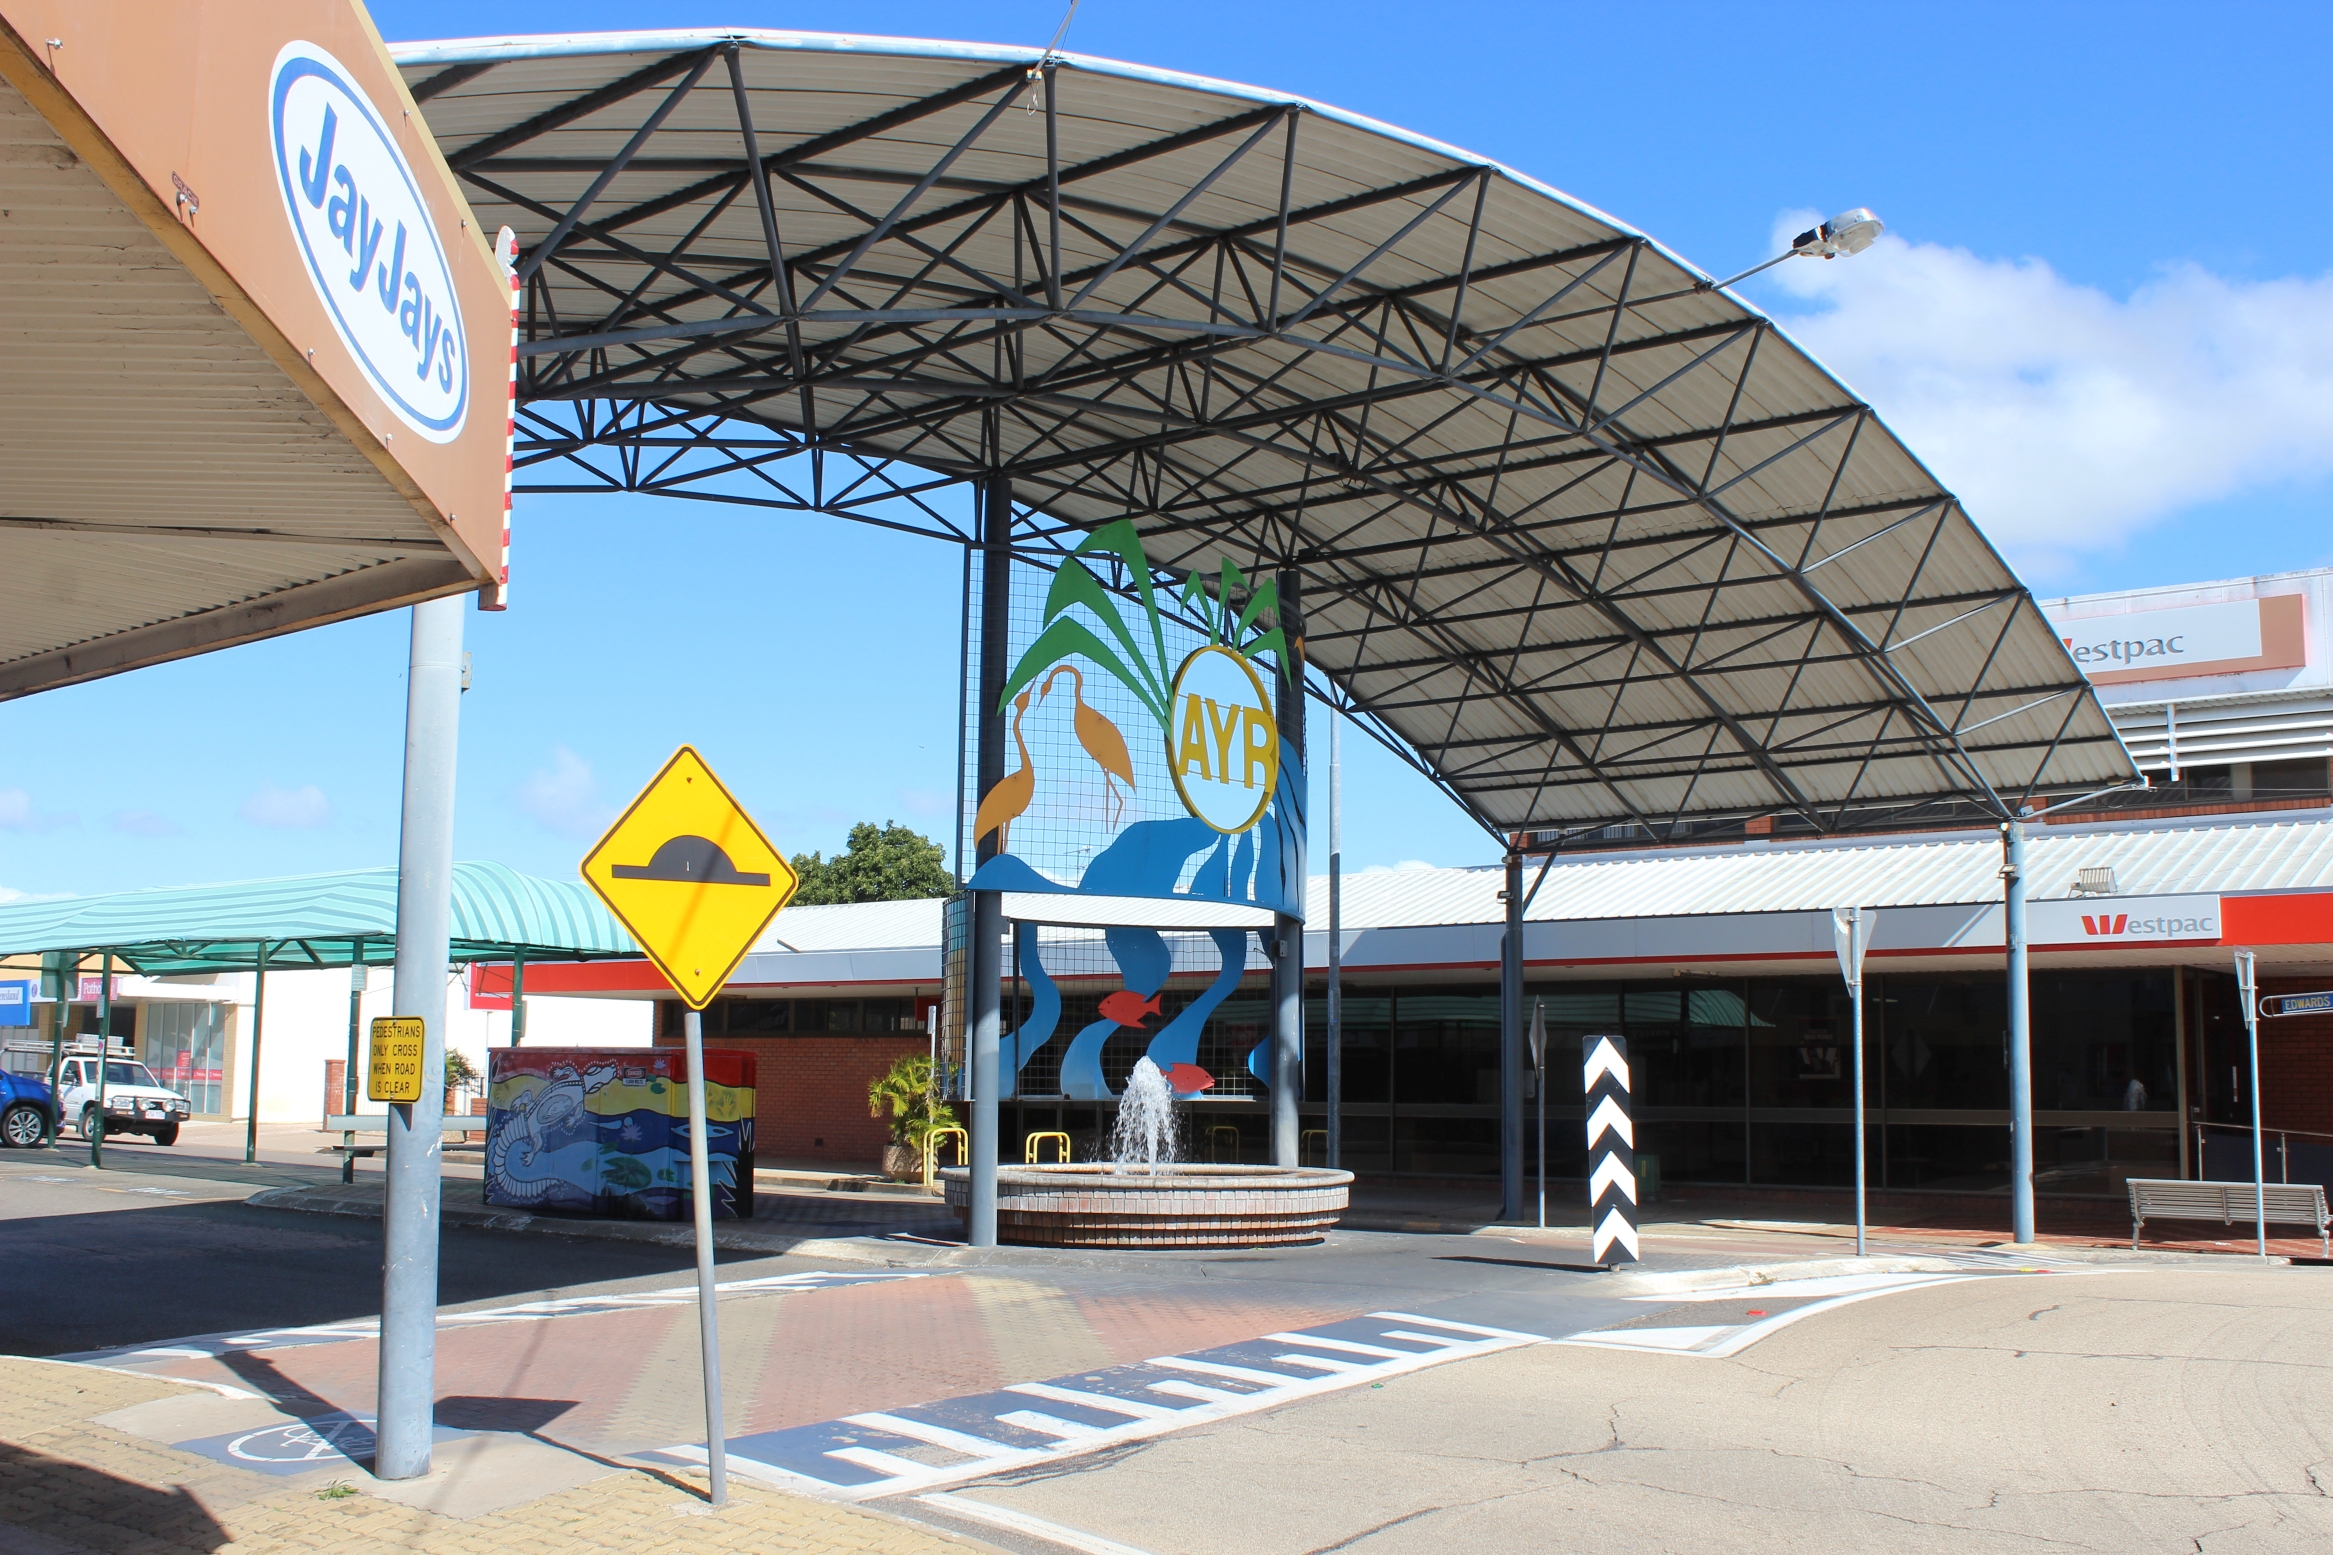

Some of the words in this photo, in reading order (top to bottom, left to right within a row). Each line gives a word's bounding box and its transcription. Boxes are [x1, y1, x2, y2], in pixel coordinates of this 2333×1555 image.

[2062, 635, 2184, 666] estpac
[1177, 692, 1276, 794] AYR
[2080, 913, 2213, 938] Westpac
[2284, 996, 2331, 1011] EDWARDS
[372, 1025, 421, 1038] PEDESTRIANS
[373, 1044, 389, 1056] ONLY
[392, 1044, 418, 1056] CROSS
[373, 1063, 391, 1075] WHEN
[394, 1063, 415, 1075] ROAD
[375, 1081, 382, 1093] IS
[384, 1081, 410, 1094] CLEAR
